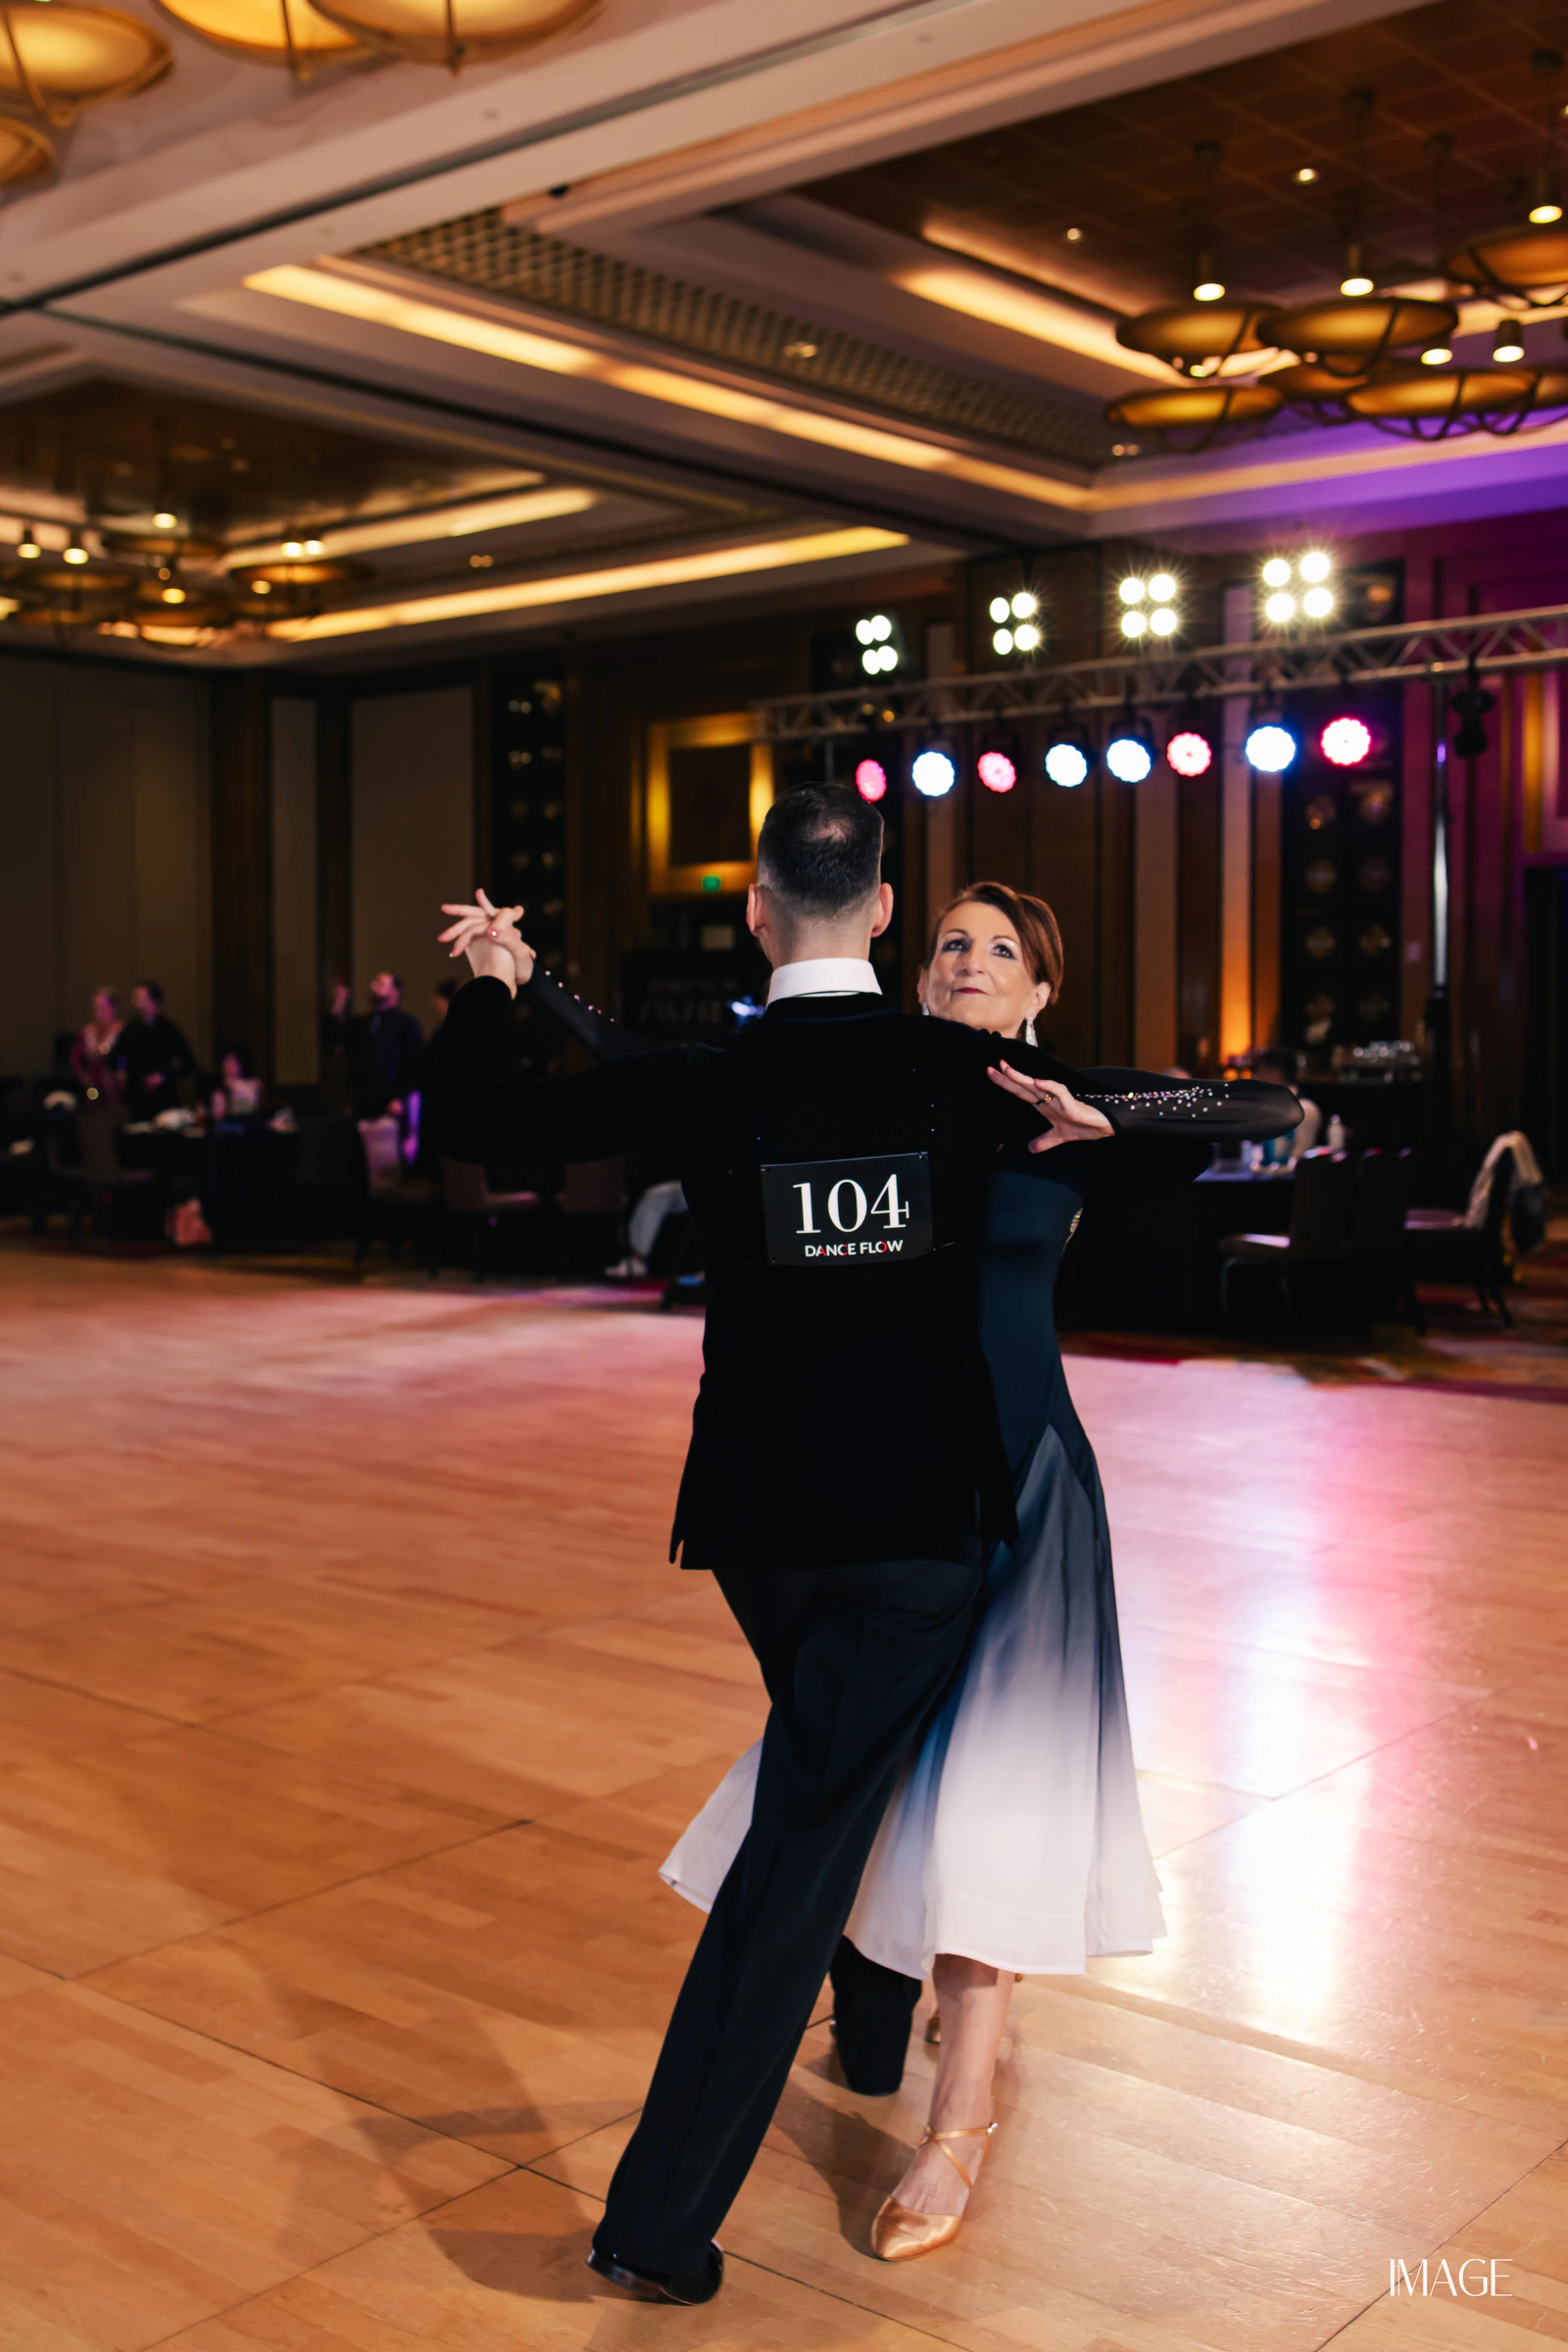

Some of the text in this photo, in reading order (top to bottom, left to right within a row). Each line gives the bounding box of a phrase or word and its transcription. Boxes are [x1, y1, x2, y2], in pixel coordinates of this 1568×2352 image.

[793, 1173, 909, 1234] 104
[805, 1240, 904, 1257] DANCE FLOW
